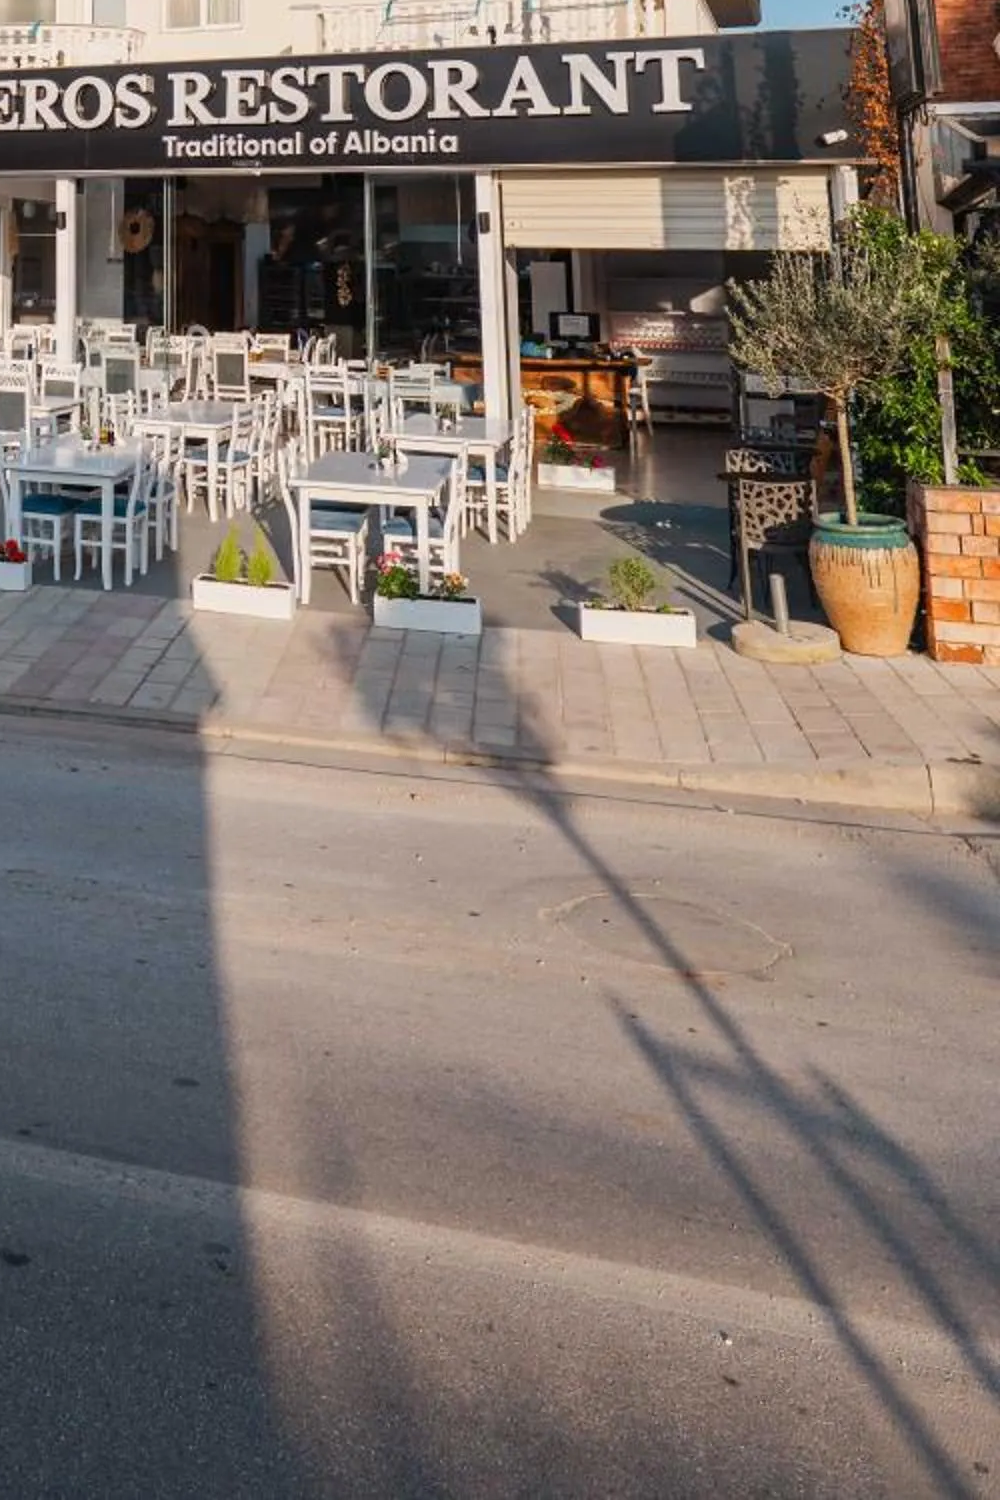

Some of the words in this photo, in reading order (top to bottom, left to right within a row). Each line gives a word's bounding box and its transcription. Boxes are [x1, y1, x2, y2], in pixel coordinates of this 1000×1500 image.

[166, 48, 706, 127] RESTORANT
[162, 132, 302, 158] Traditional
[308, 131, 338, 155] of
[343, 129, 459, 155] Albania
